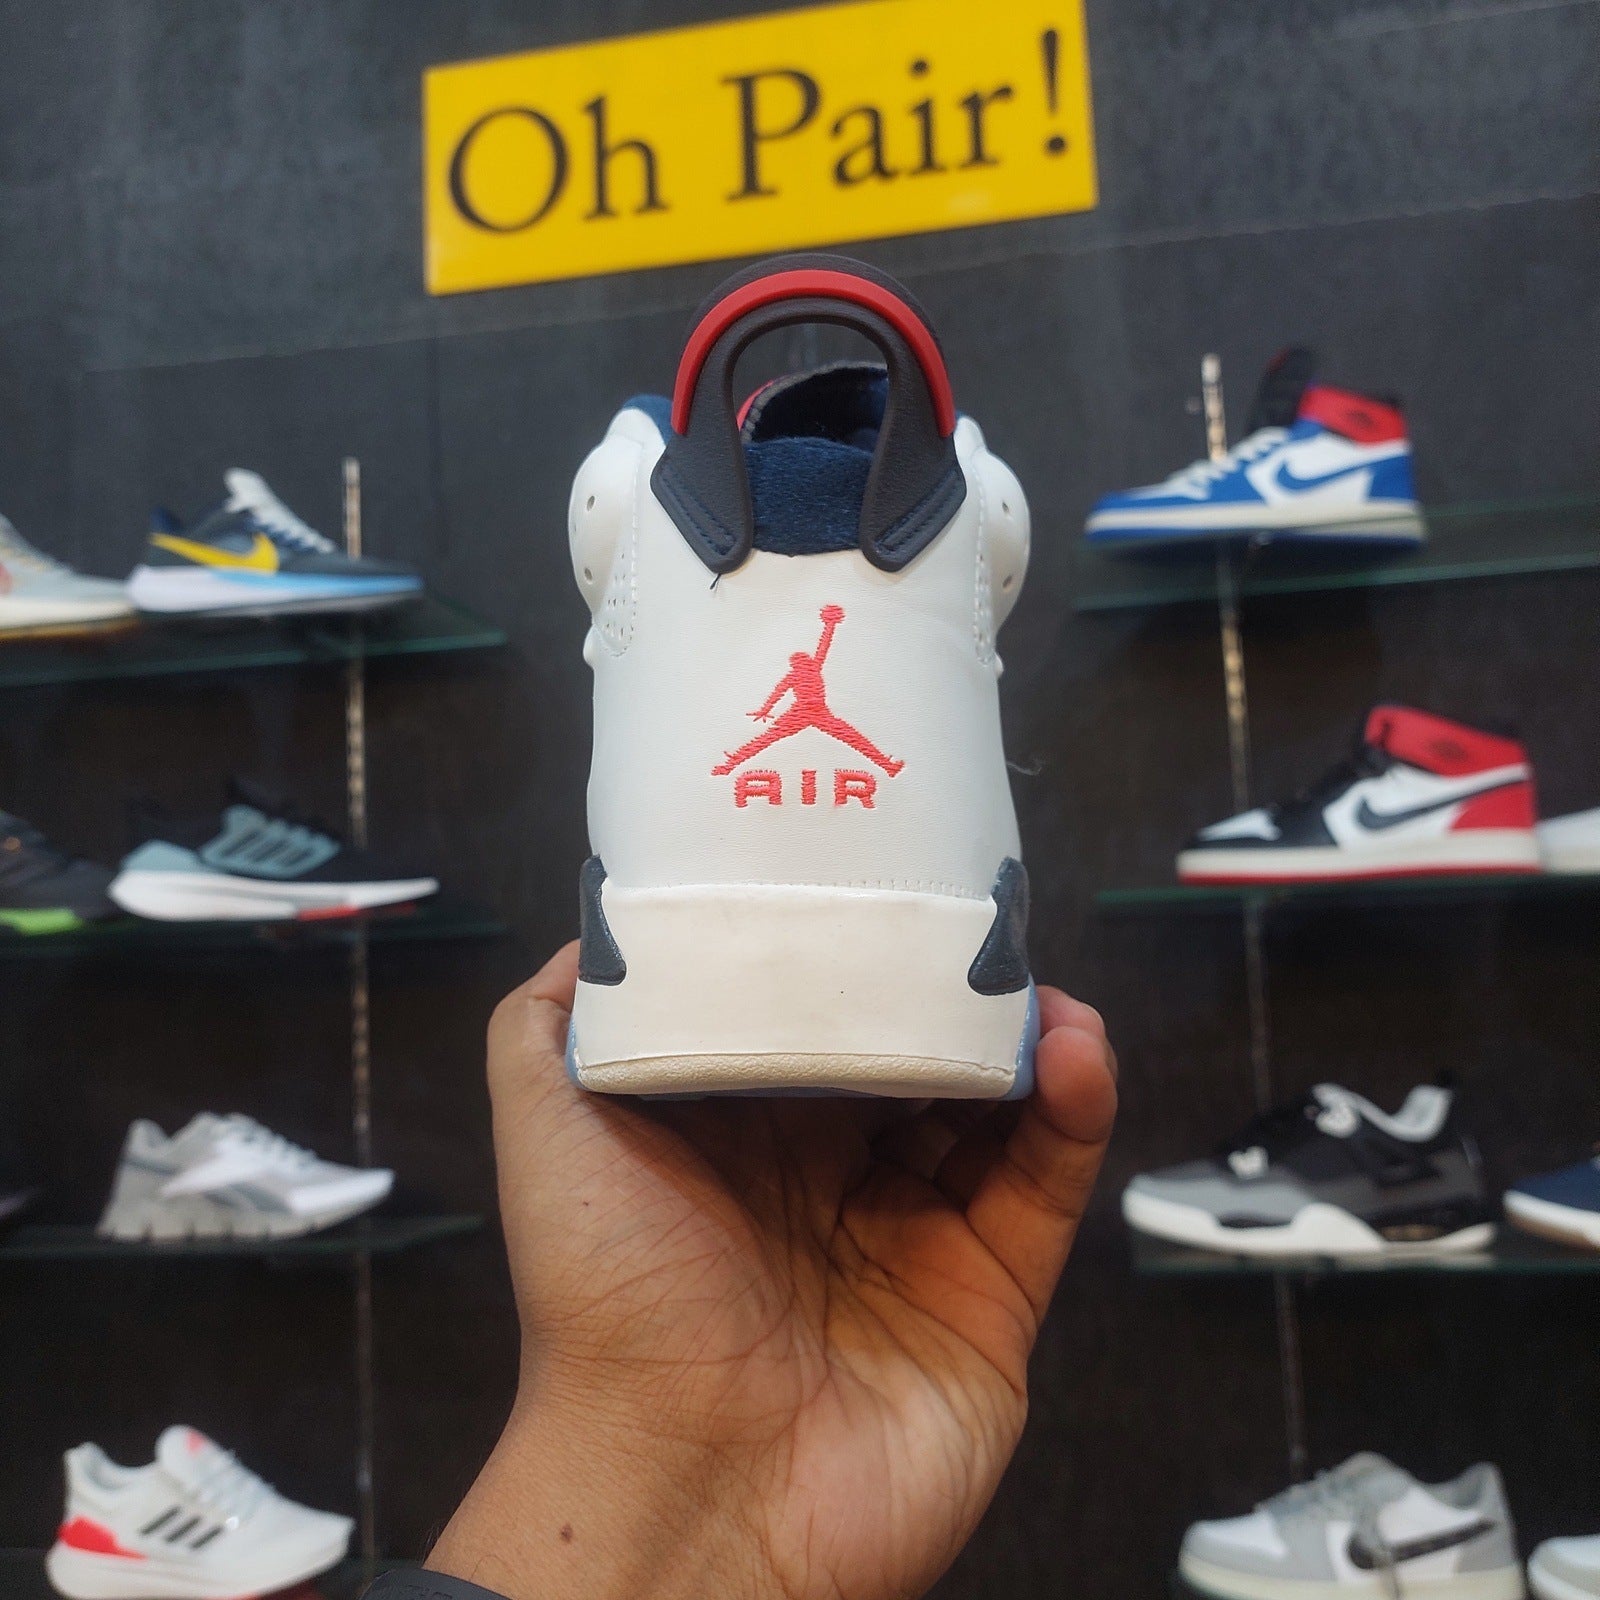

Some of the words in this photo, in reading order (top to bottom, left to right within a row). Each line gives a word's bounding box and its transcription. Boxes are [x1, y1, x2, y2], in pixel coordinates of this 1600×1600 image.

[447, 94, 671, 235] Oh
[720, 27, 1069, 202] Pair!
[735, 768, 877, 809] AIR
